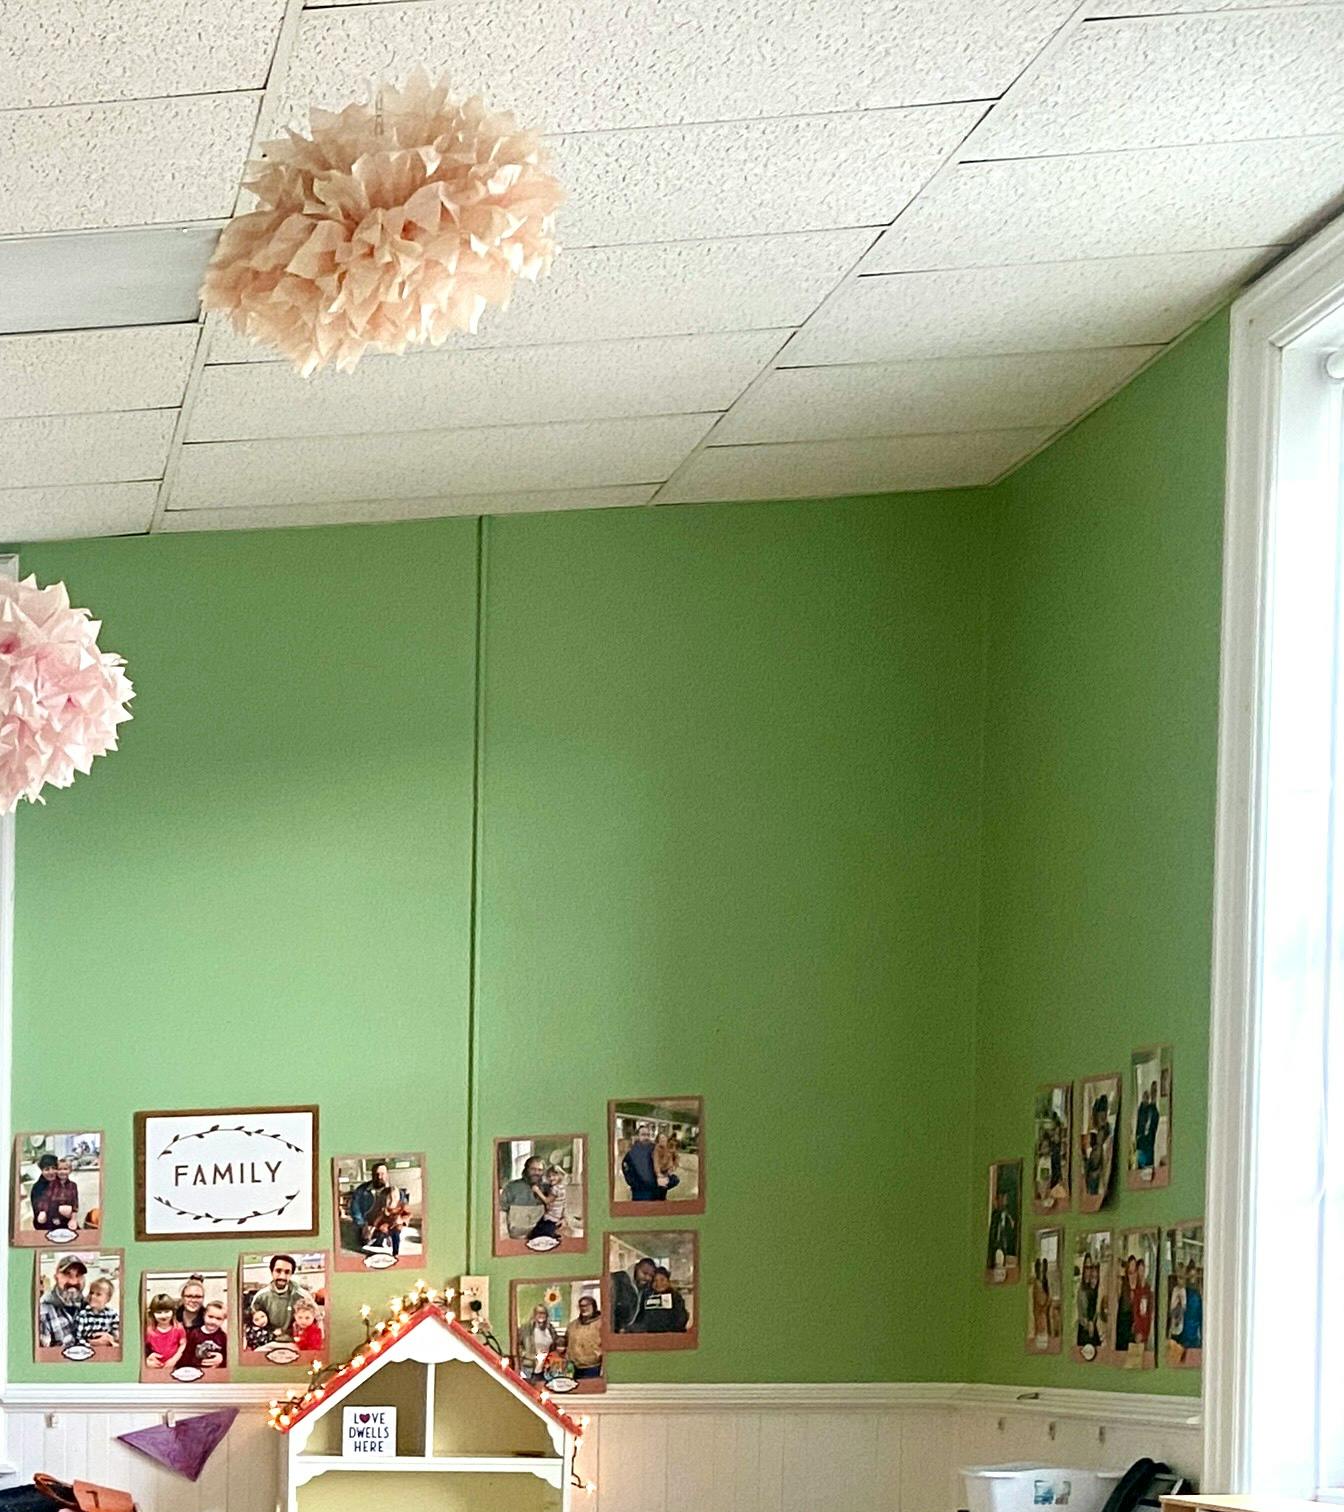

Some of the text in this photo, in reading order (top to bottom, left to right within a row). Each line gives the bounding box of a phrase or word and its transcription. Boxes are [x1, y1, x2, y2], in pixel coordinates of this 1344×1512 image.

[174, 1161, 282, 1187] FAMILY
[348, 1426, 390, 1439] DWELLS
[354, 1440, 384, 1453] HERE
